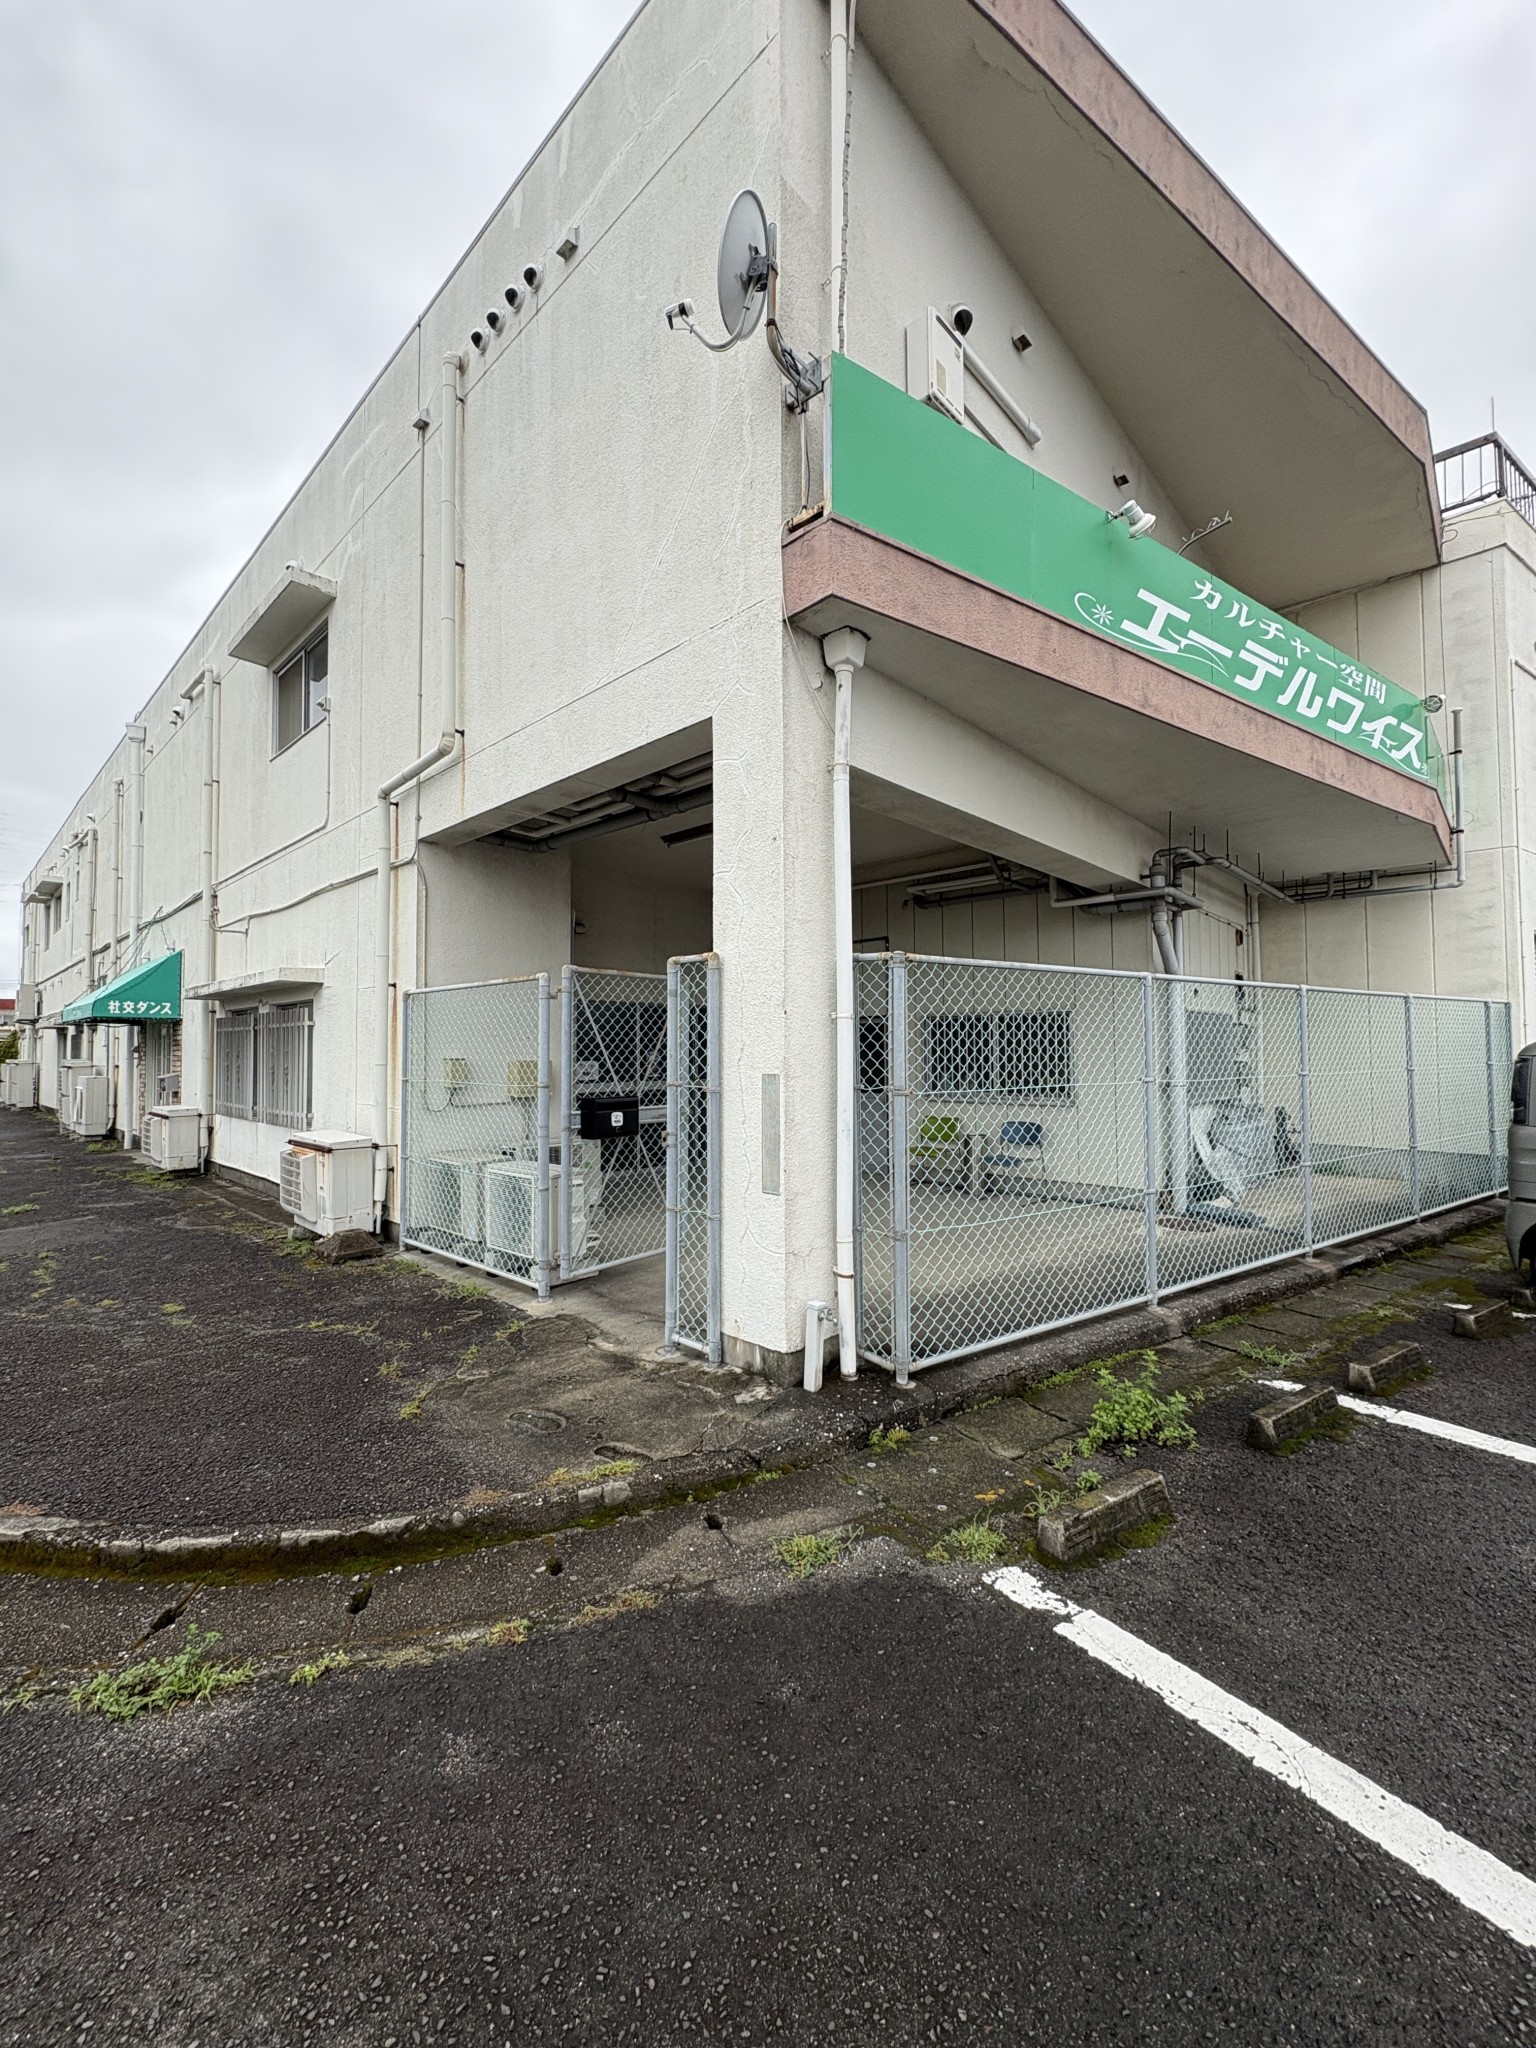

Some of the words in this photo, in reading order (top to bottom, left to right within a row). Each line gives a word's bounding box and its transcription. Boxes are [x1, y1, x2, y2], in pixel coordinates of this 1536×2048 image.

[1120, 588, 1424, 768] エーデルワイス
[1189, 579, 1387, 704] カルチャー空間
[108, 1000, 172, 1015] 社交ダンス
